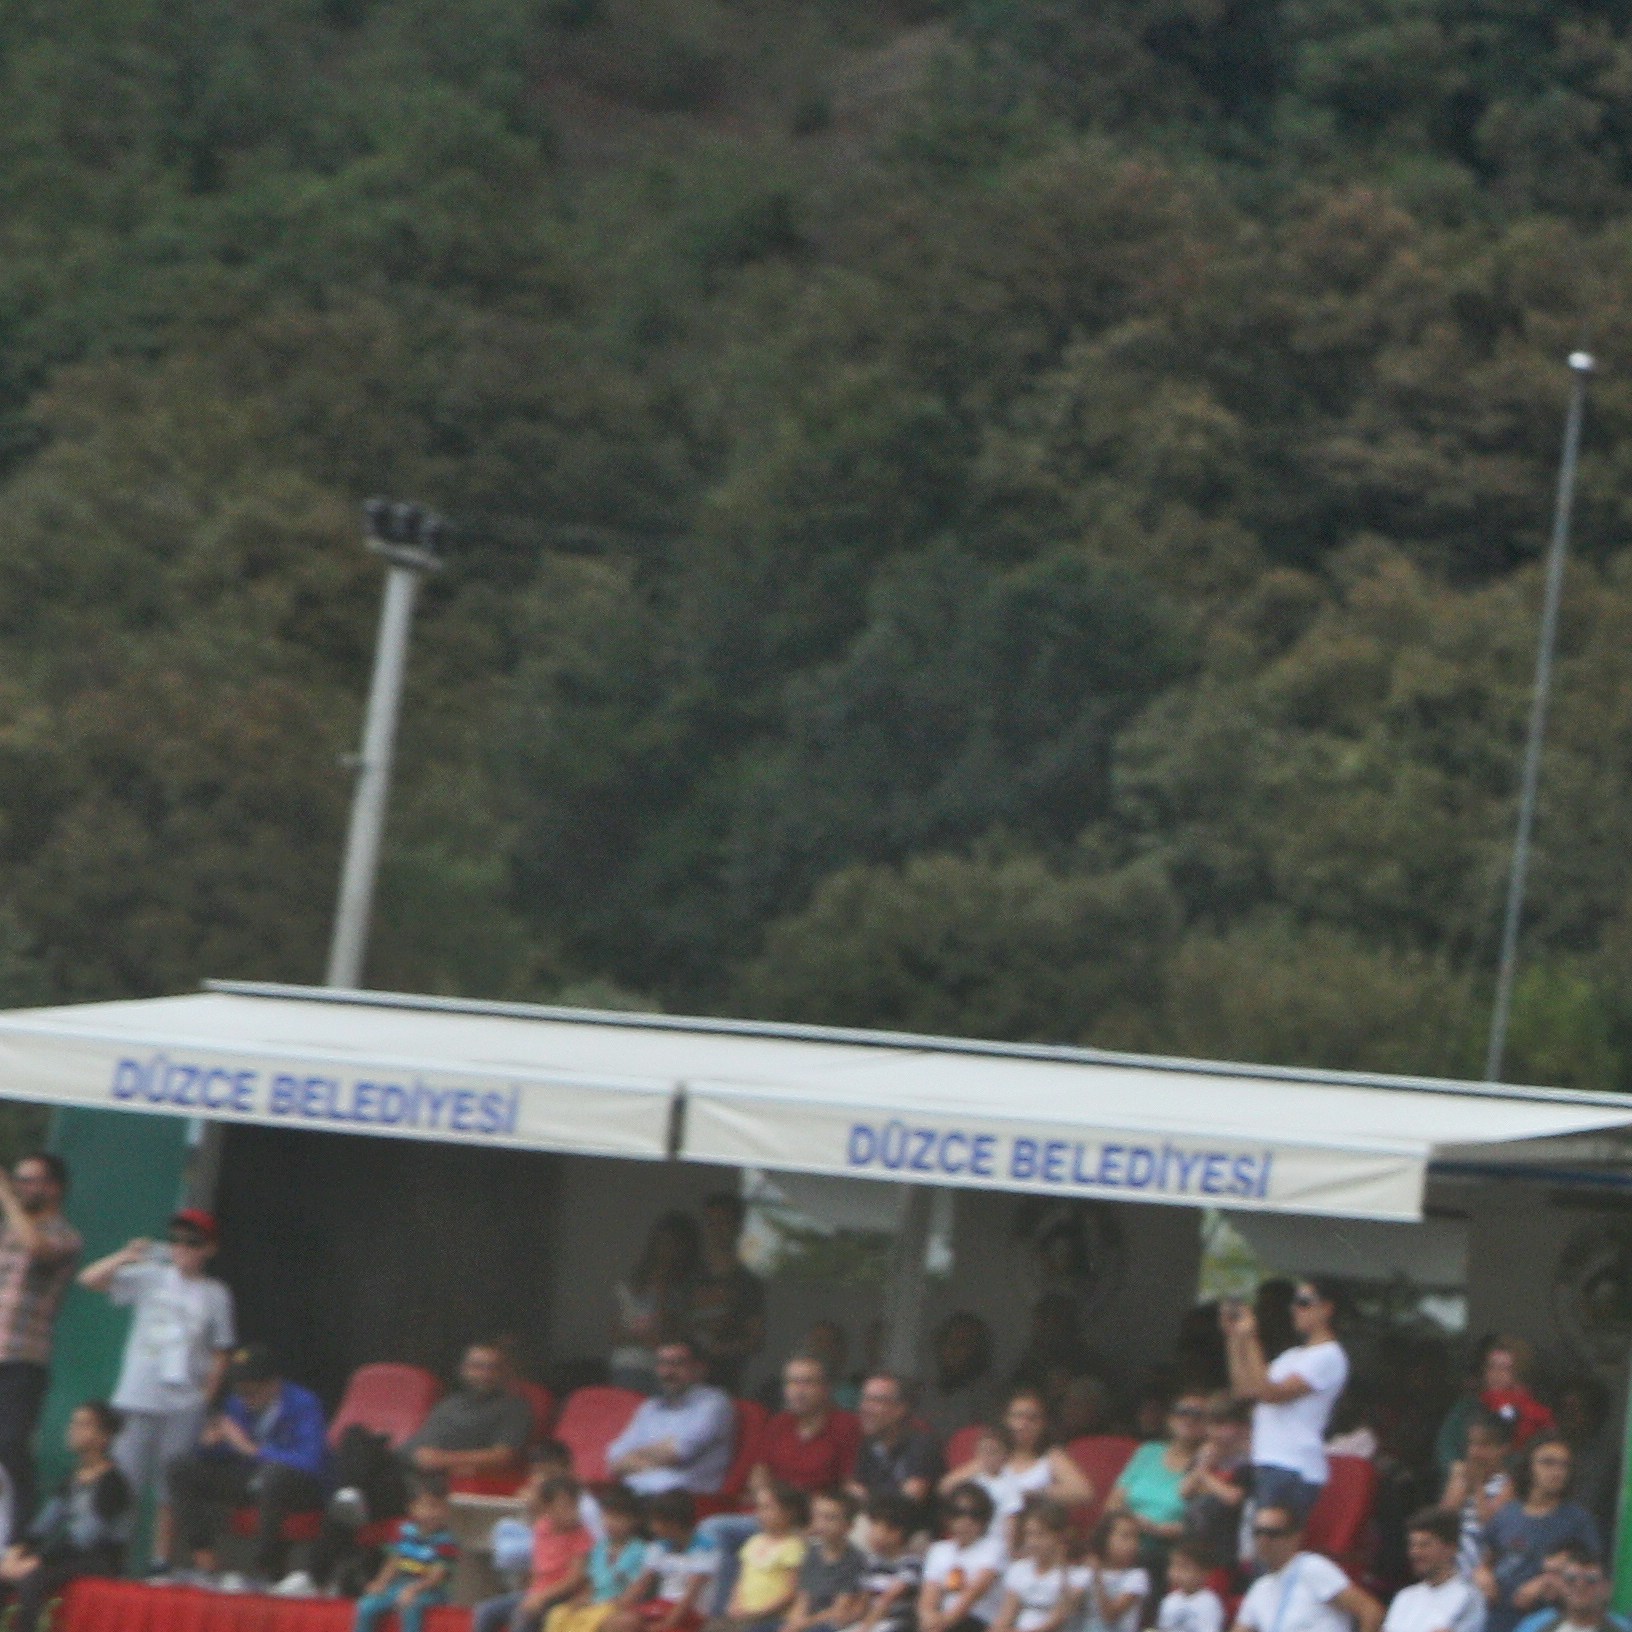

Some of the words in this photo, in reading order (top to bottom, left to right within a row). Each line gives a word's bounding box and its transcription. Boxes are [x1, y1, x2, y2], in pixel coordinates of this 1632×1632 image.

[113, 1051, 259, 1113] DÜZCE
[270, 1072, 522, 1135] BELEDİYESİ
[848, 1120, 997, 1176] DÜZCE
[1010, 1136, 1273, 1199] BELEDİYESİ
